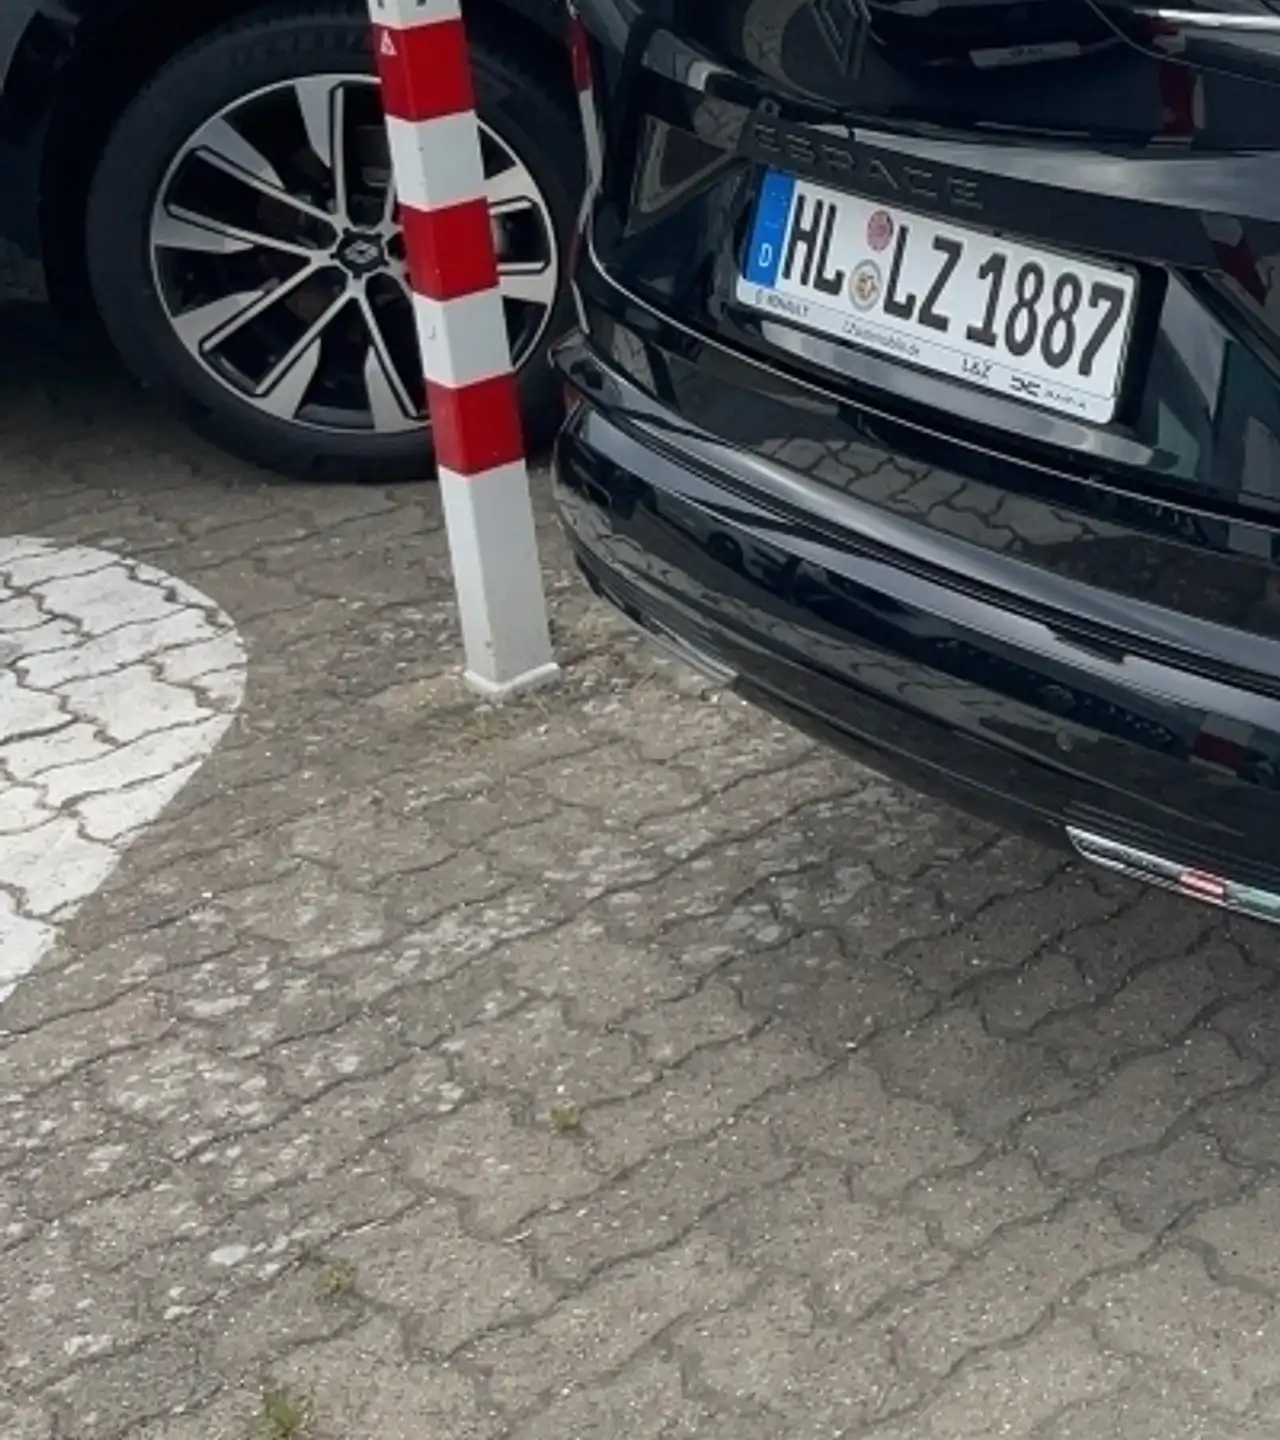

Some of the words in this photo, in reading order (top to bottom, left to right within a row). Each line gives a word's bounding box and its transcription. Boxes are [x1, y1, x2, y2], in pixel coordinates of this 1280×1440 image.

[782, 193, 845, 297] HL
[882, 224, 964, 333] LZ
[966, 252, 1126, 377] 1887
